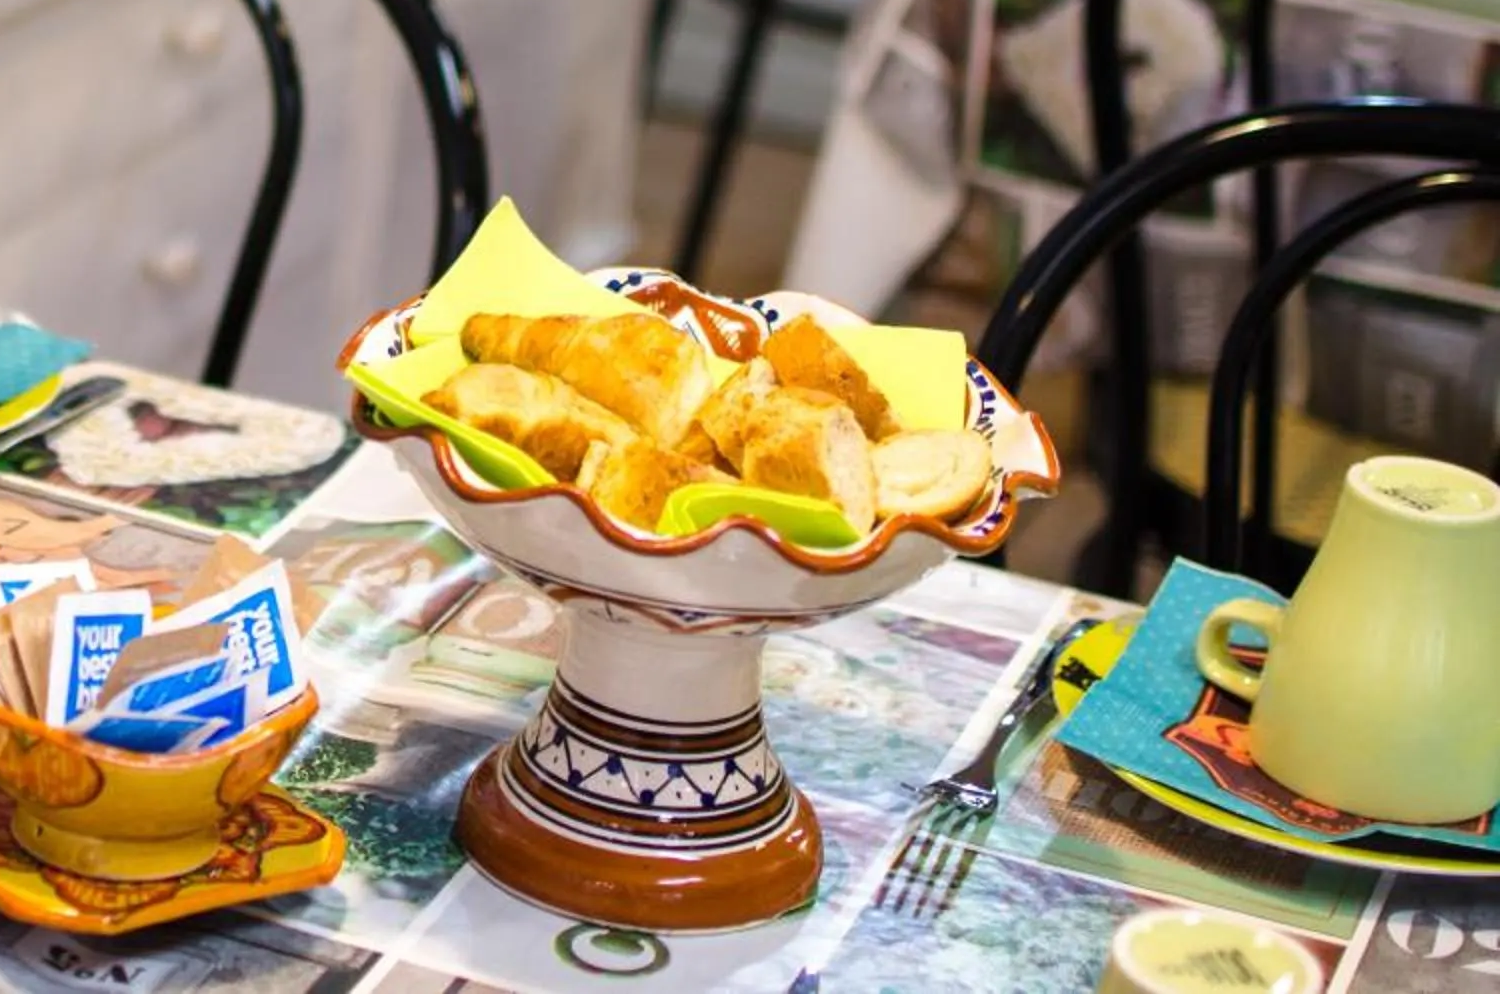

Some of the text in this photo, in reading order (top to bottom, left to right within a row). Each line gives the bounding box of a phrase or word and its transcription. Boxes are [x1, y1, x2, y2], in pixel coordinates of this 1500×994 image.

[77, 624, 123, 652] your
[250, 599, 280, 666] your
[78, 649, 118, 681] bes
